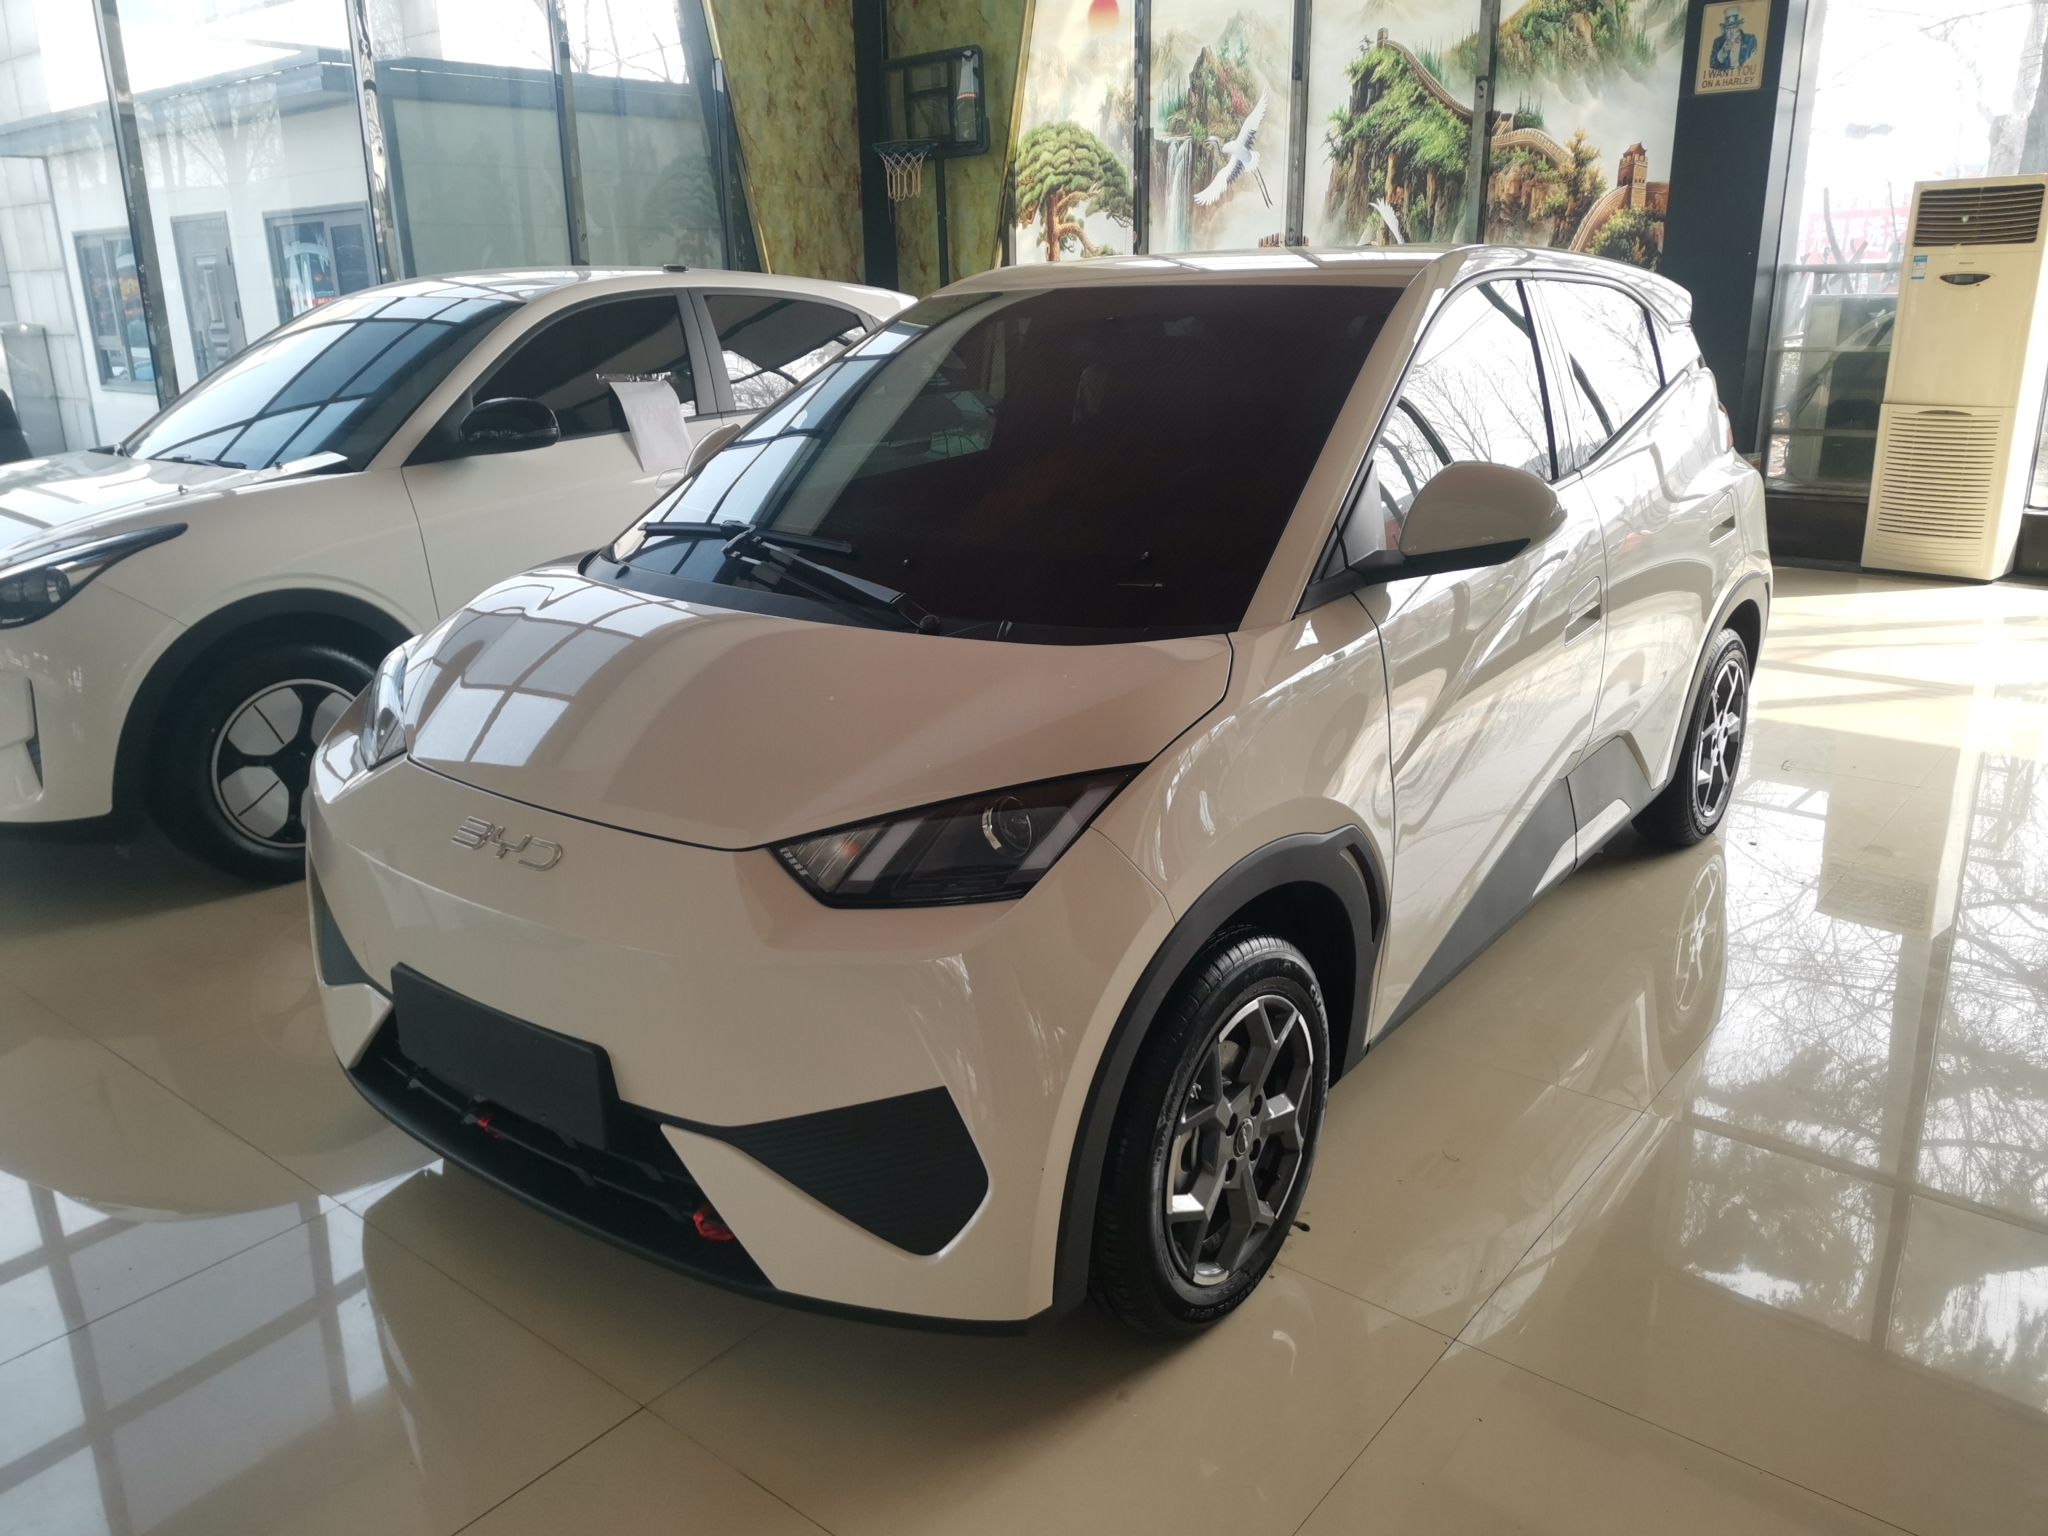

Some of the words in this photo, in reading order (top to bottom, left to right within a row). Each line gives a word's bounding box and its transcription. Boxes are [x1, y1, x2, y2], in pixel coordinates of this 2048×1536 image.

[1708, 69, 1735, 79] WANT
[1736, 64, 1757, 77] YOU
[1702, 80, 1714, 89] ON
[1715, 79, 1721, 87] A
[1723, 76, 1754, 86] HARLEY
[451, 815, 563, 872] BYD
